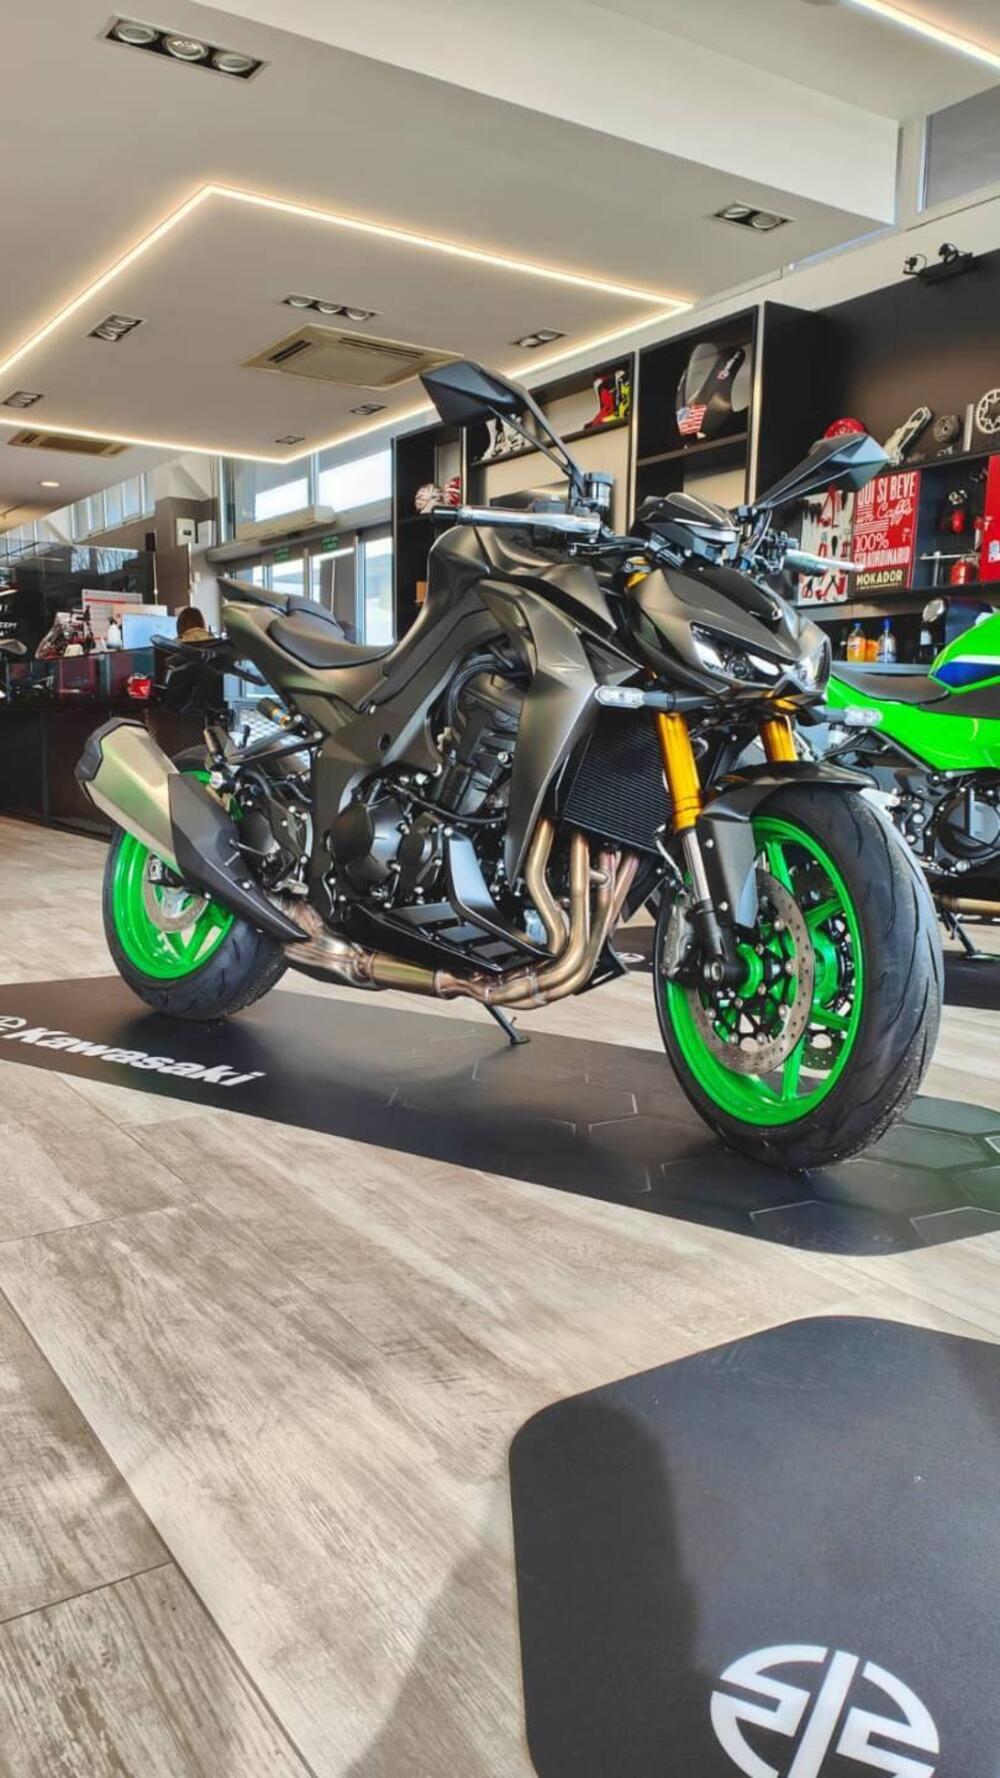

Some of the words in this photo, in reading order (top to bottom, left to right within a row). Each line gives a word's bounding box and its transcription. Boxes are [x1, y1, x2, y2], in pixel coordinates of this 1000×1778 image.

[877, 476, 889, 504] SI
[889, 471, 918, 501] BEVE
[854, 532, 890, 553] 100%
[856, 569, 904, 587] MOKADOR
[2, 1027, 267, 1087] Kawasaki
